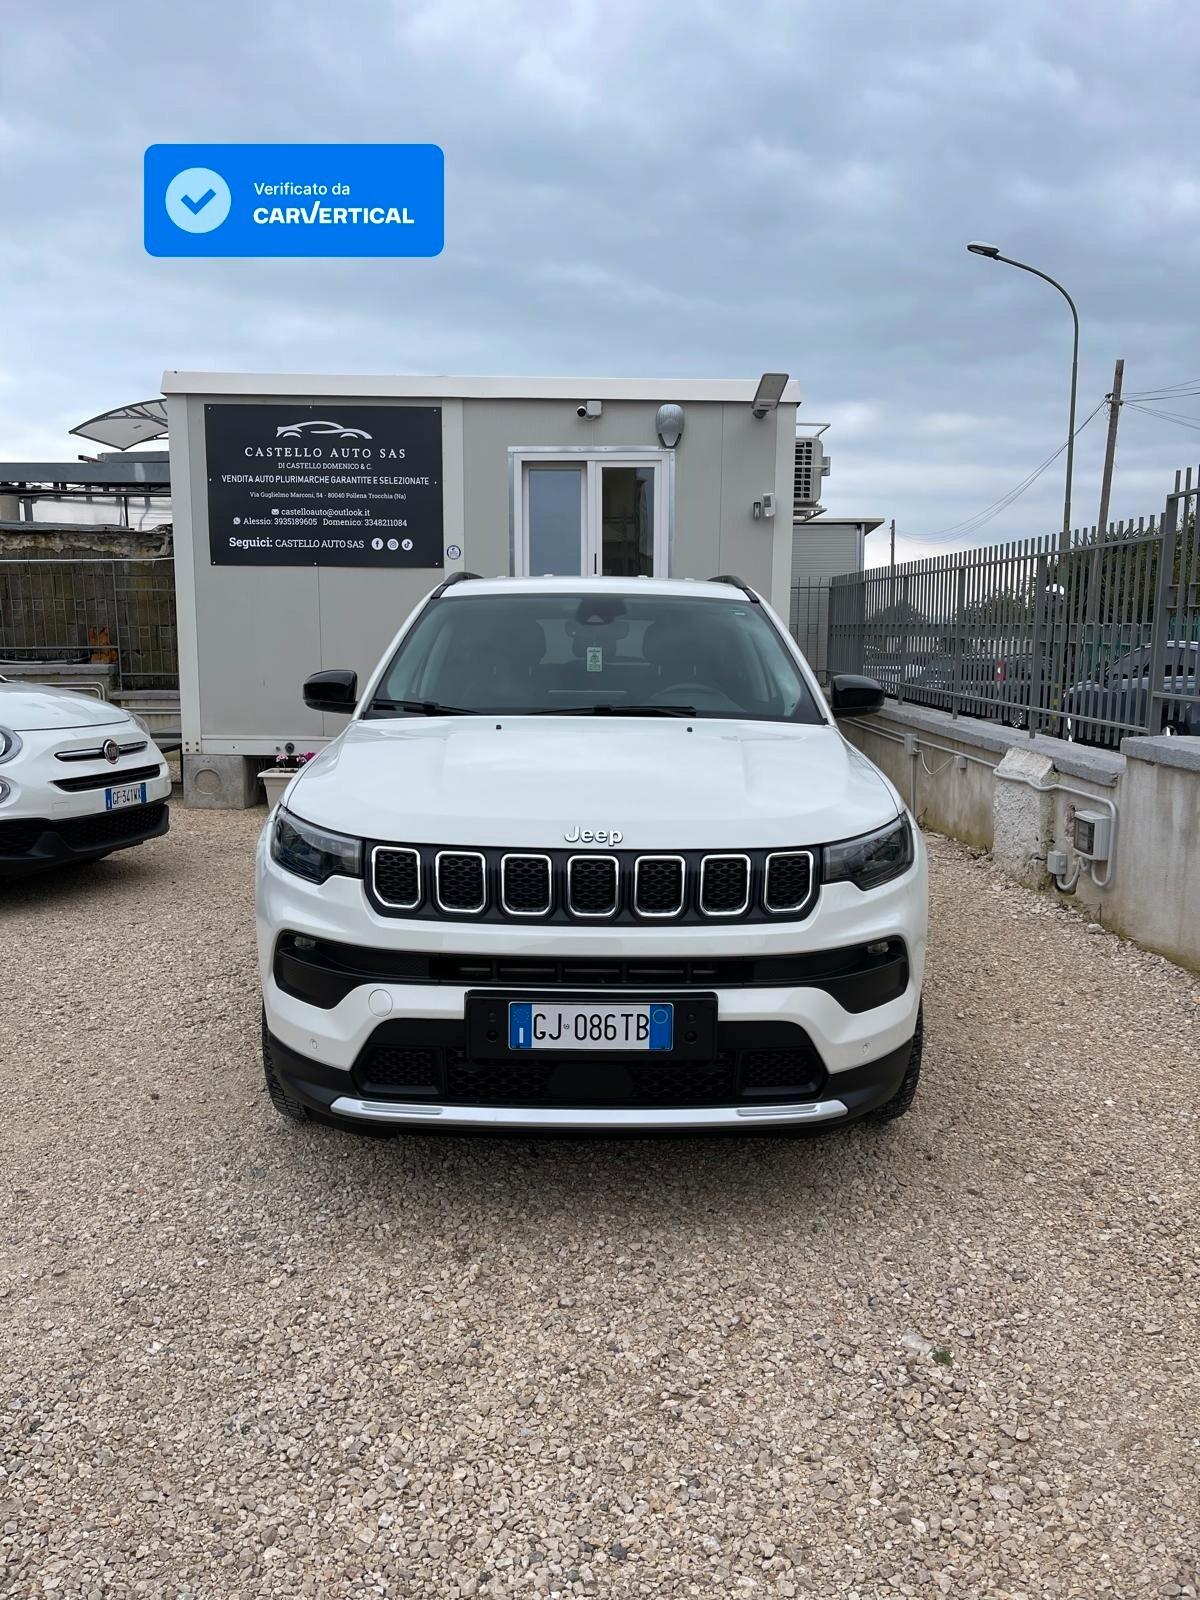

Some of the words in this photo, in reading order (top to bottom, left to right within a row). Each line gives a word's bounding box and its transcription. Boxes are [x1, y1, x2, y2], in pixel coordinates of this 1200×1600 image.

[244, 447, 323, 458] CASTELLO
[329, 447, 372, 459] AUTO
[379, 448, 406, 459] SAS
[286, 462, 321, 470] CASTELLO
[322, 462, 360, 470] DOMENICO
[221, 474, 254, 483] VENDITA
[254, 475, 275, 483] AUTO
[275, 475, 330, 484] PLURIMARCHE
[330, 475, 372, 484] GARANTITE
[372, 476, 379, 485] E
[379, 476, 430, 485] SELEZIONATE
[260, 491, 290, 499] Guglielmo
[281, 507, 371, 517] castelloauto@outlook.it
[243, 517, 273, 526] Alessio:
[274, 518, 318, 526] 3935189605
[364, 519, 408, 527] 3348211084
[228, 536, 273, 550] Seguici:
[275, 539, 321, 548] CASTELLO
[321, 539, 347, 548] AUTO
[346, 540, 365, 549] SAS
[564, 825, 623, 847] Jeep
[533, 1013, 562, 1041] GJ
[574, 1013, 650, 1041] 086TB
